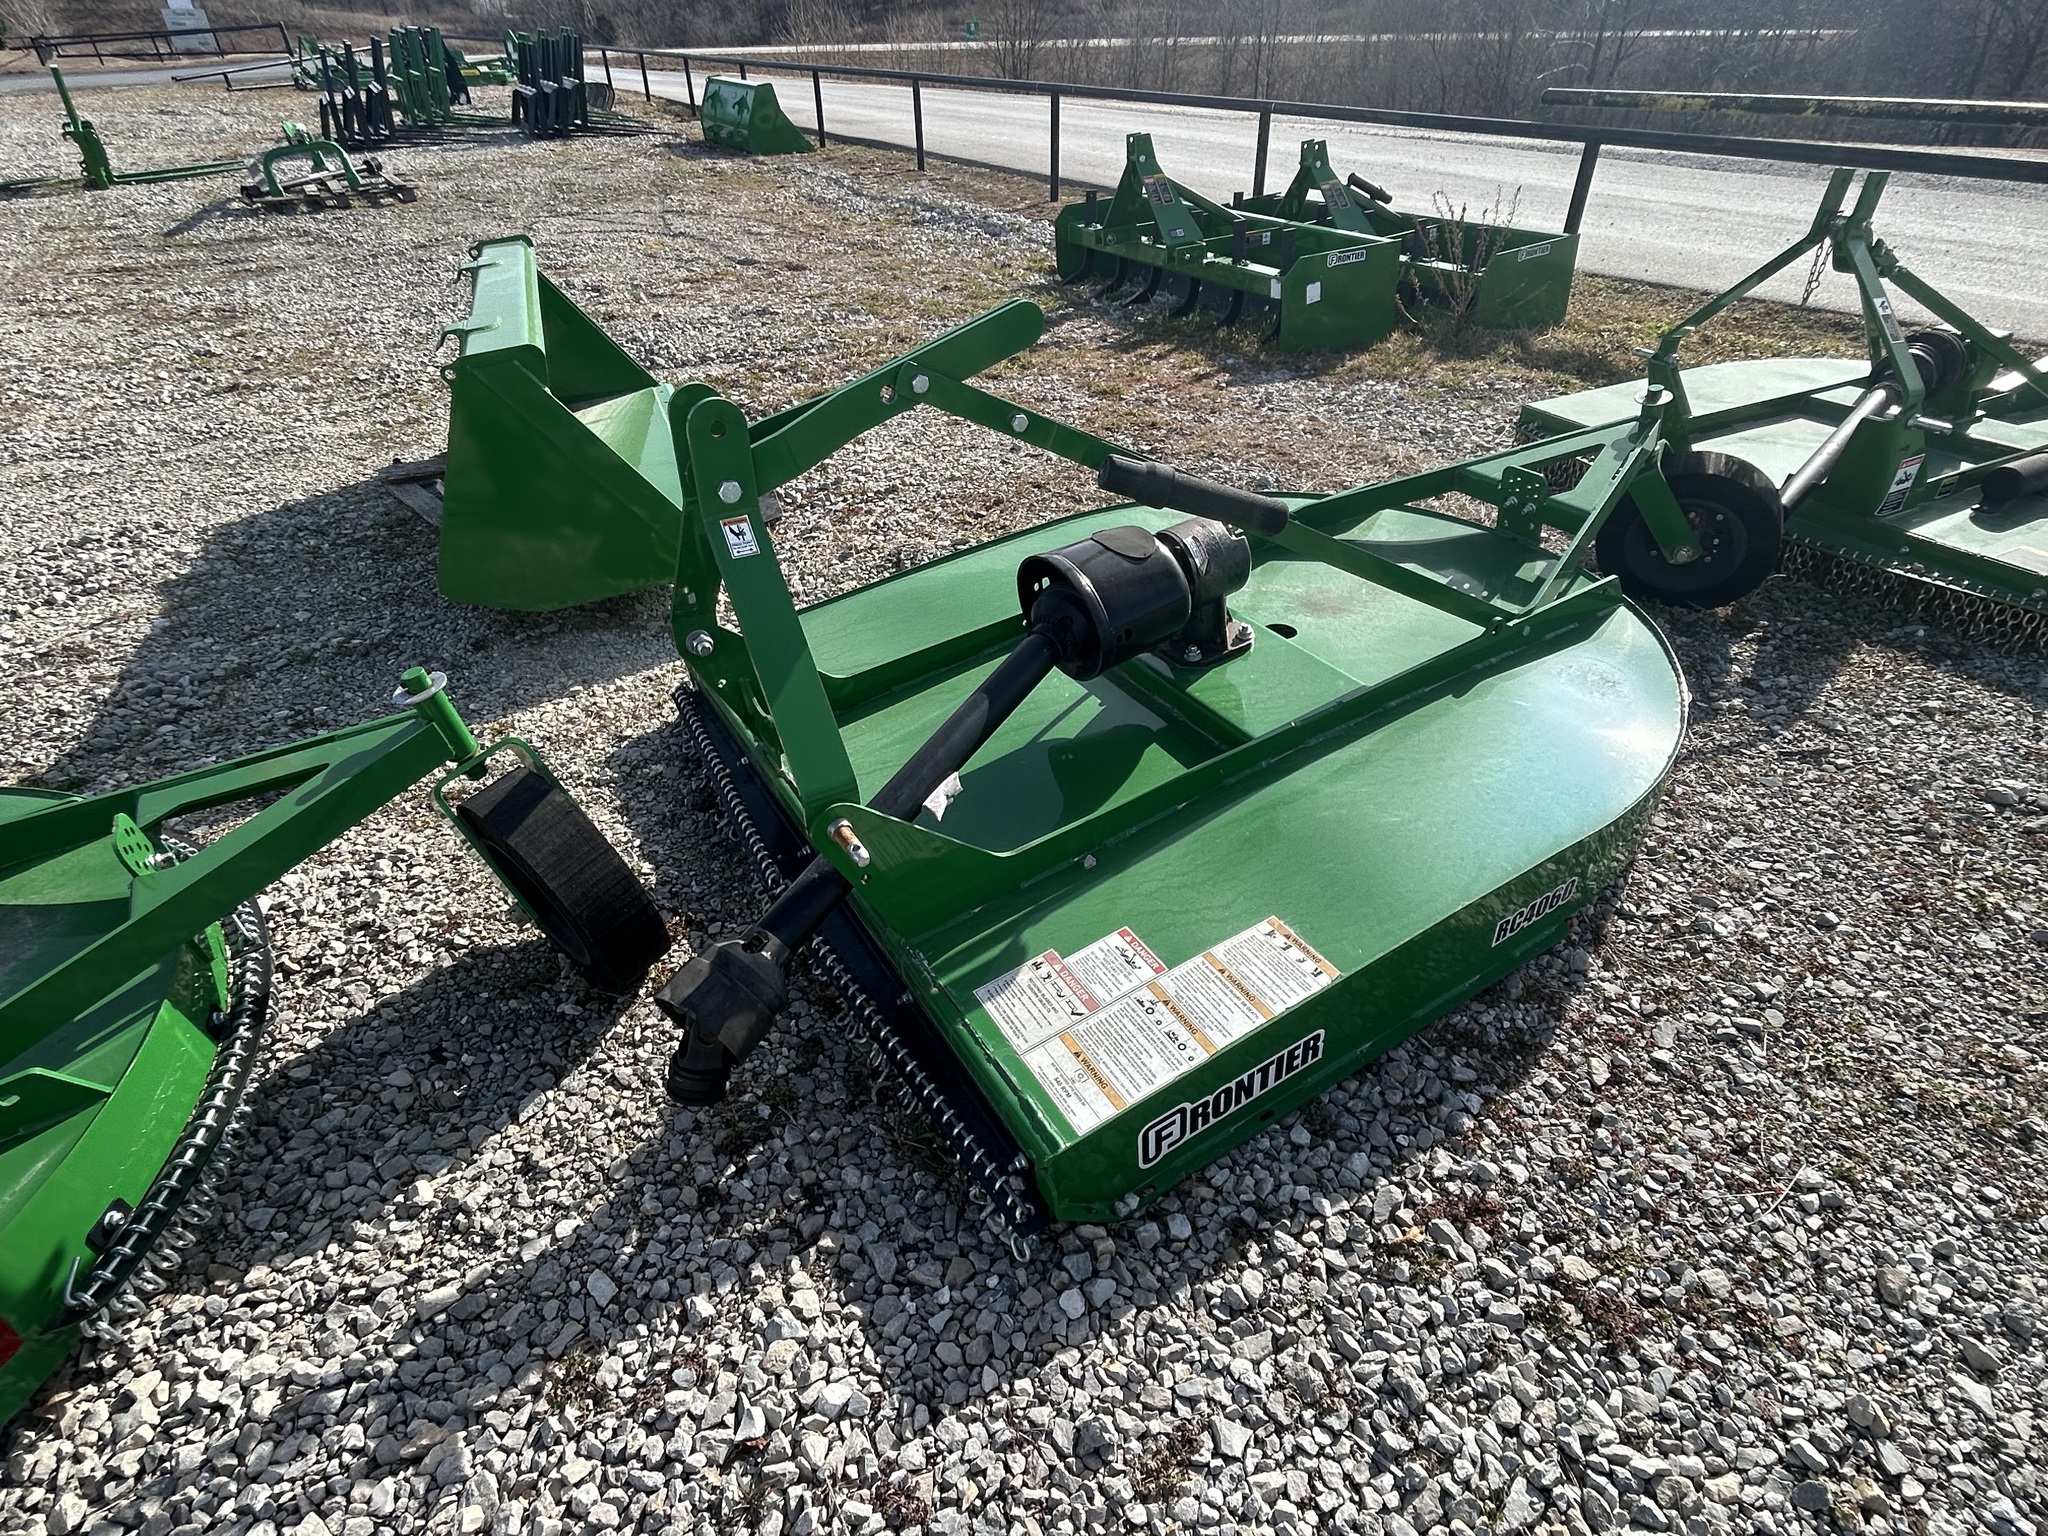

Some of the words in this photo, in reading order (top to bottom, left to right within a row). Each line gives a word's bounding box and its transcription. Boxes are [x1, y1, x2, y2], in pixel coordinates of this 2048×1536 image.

[1328, 251, 1365, 267] FRONTIER
[1494, 878, 1577, 945] RC4060
[1130, 941, 1160, 969] DANGER
[1291, 938, 1322, 963] WARNING
[1059, 969, 1090, 1001] DANGER
[1225, 973, 1256, 1002] WARNING
[1168, 1005, 1198, 1035] WARNING
[1079, 1057, 1108, 1089] WARNING
[1141, 1032, 1322, 1167] FRONTIER
